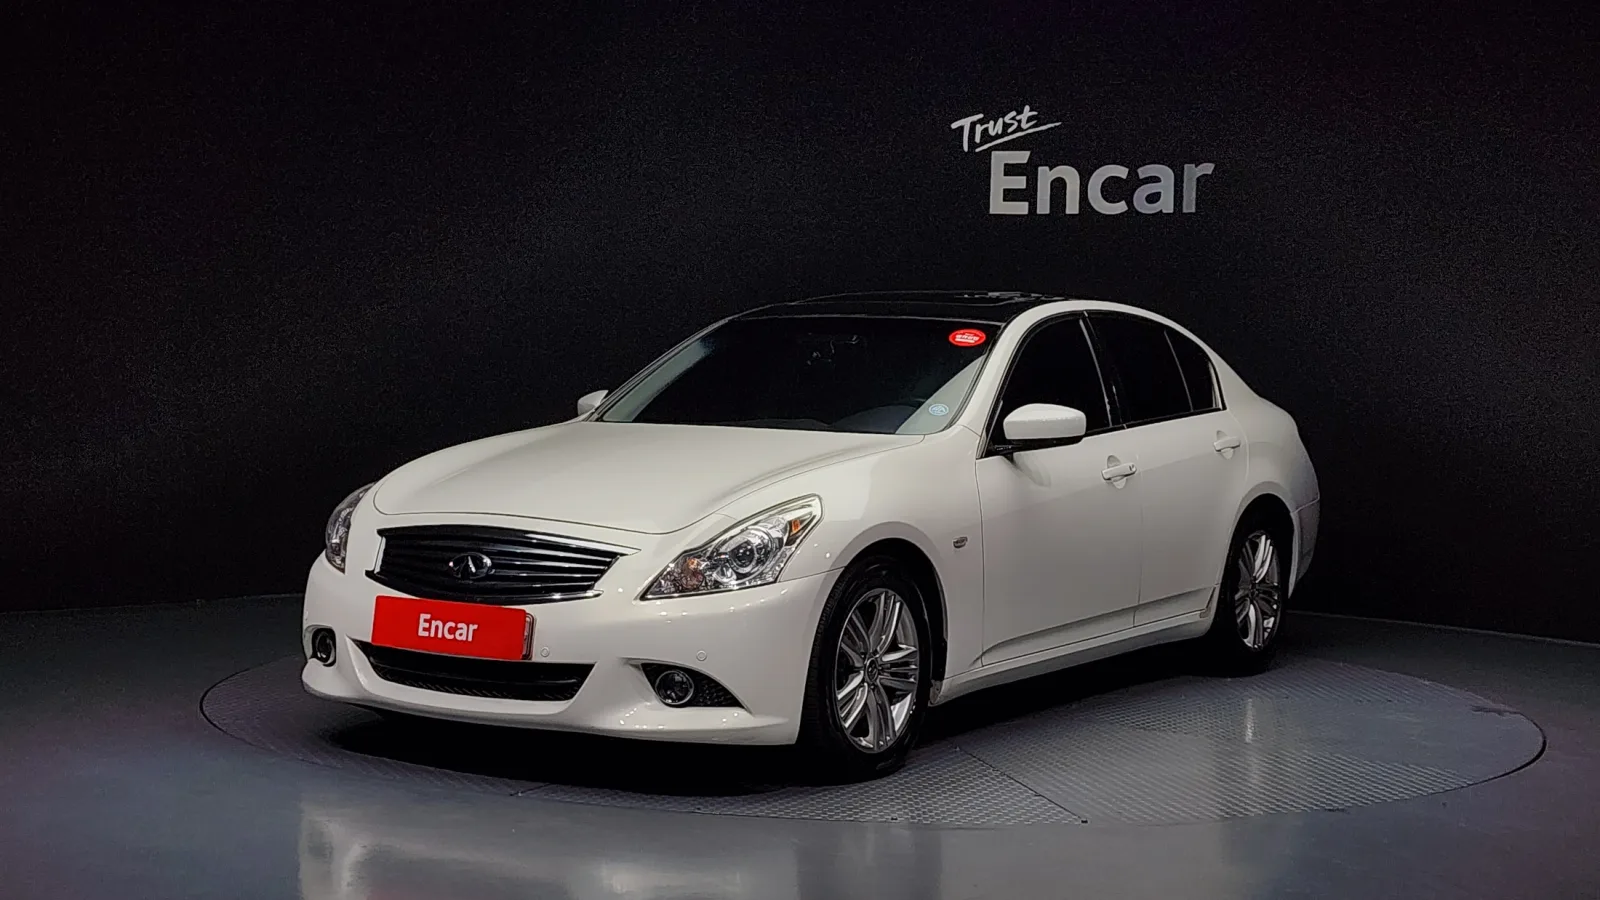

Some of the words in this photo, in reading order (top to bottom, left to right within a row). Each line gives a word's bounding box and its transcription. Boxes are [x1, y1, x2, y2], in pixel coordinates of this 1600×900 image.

[951, 105, 1038, 152] Trust
[989, 150, 1215, 215] Encar
[418, 613, 478, 642] Encar
